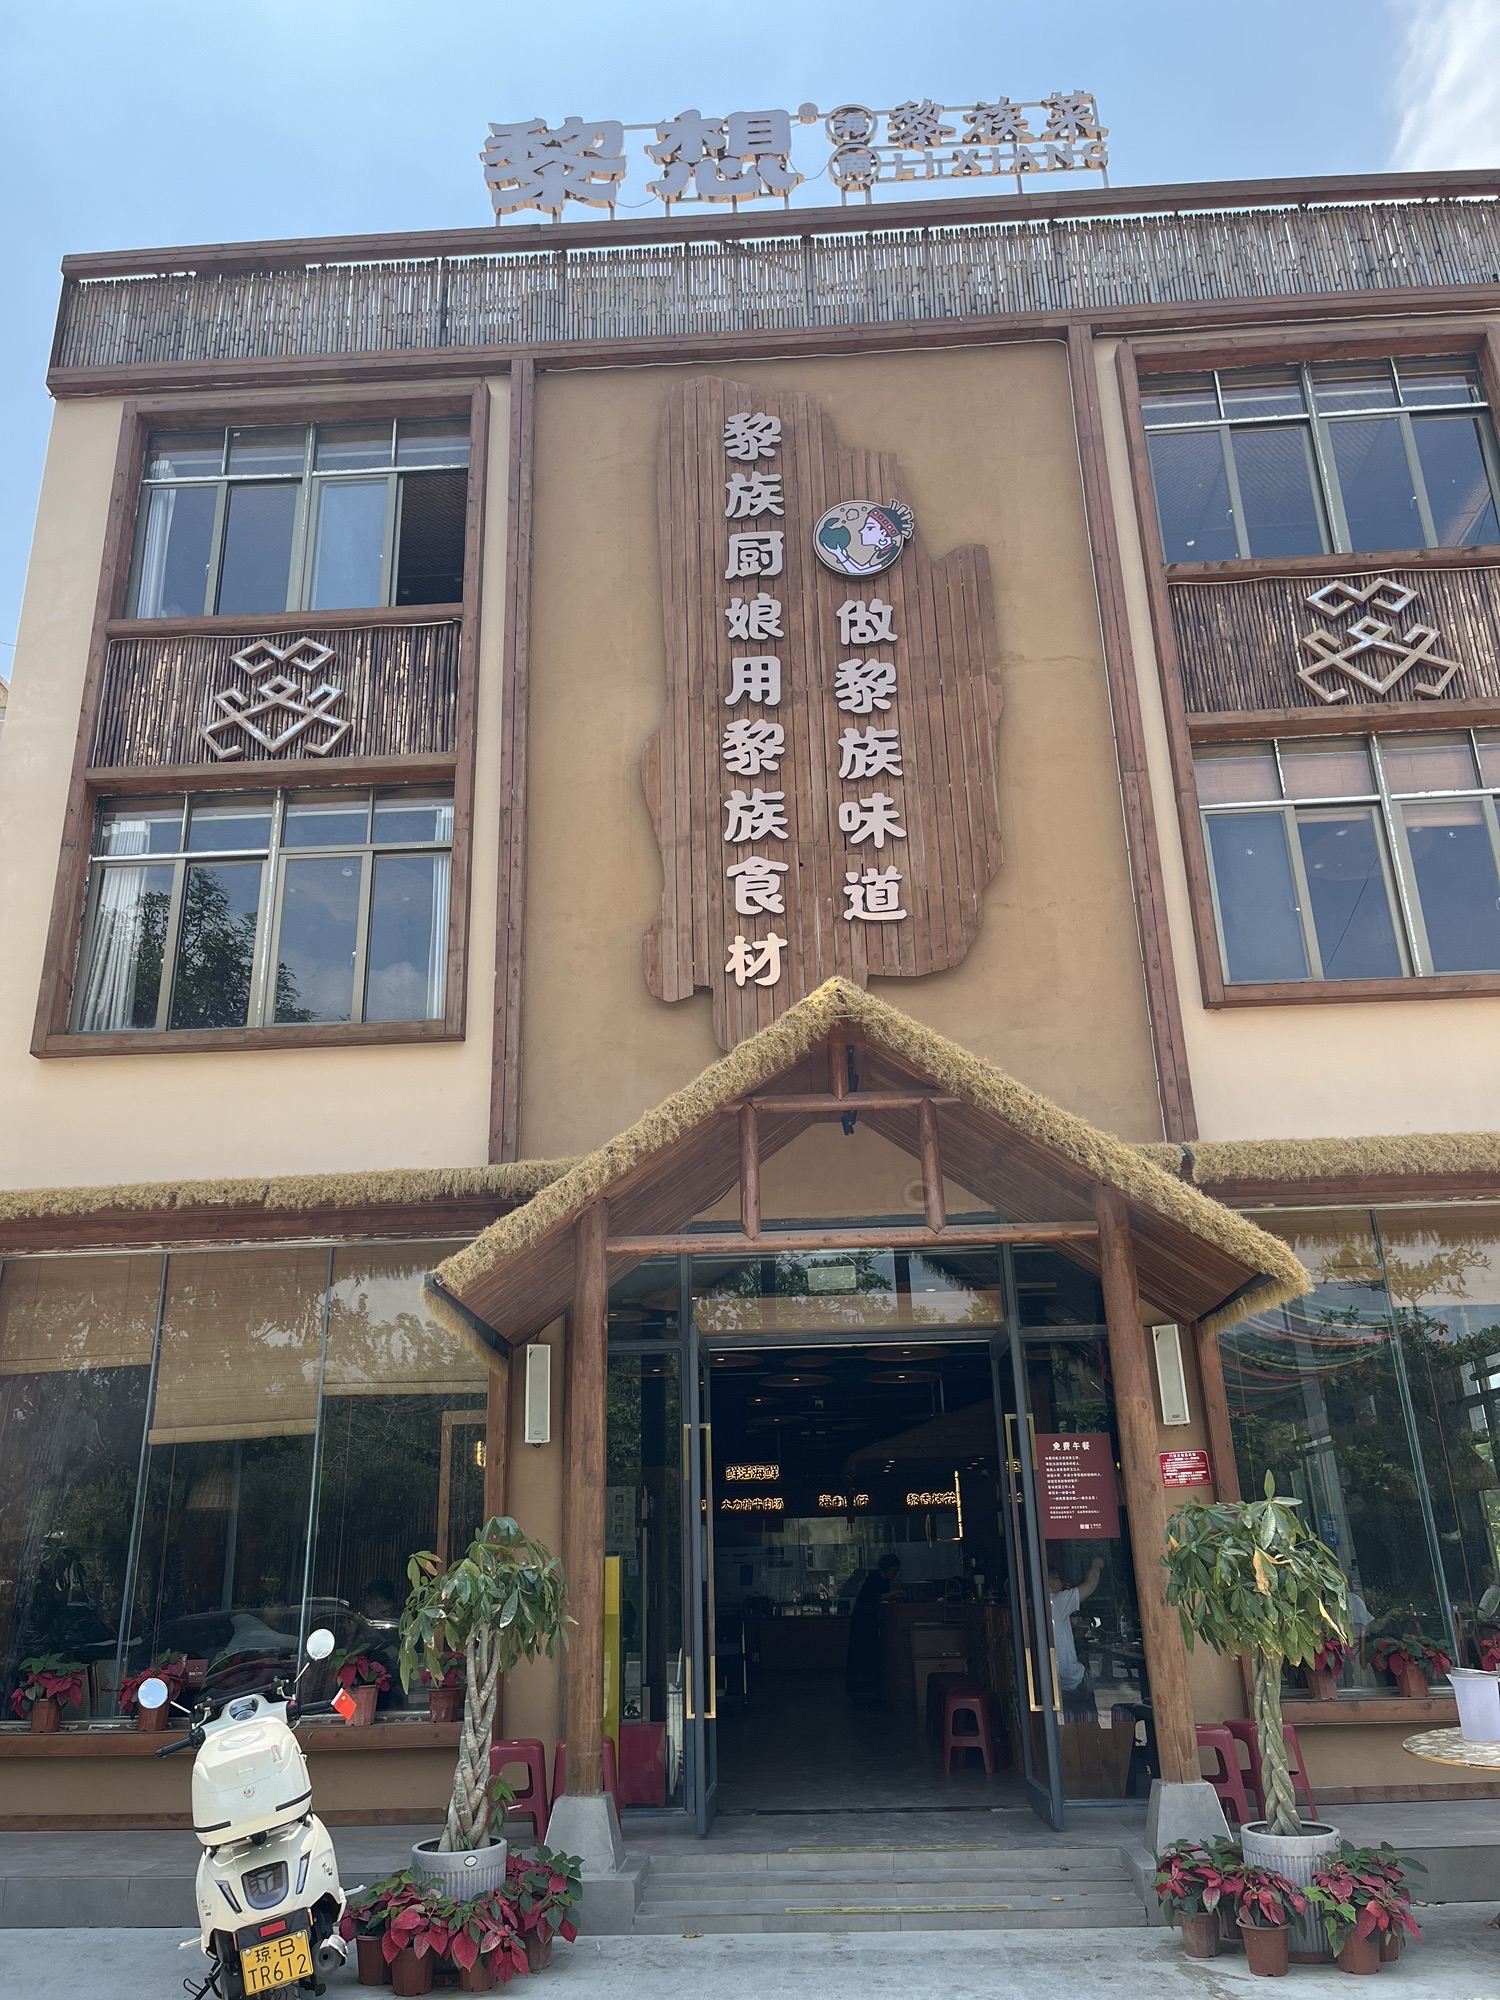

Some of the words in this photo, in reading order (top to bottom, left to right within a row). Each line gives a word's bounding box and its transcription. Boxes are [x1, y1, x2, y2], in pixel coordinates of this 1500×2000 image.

[829, 106, 880, 191] 海南
[888, 90, 1110, 151] 黎族菜
[480, 108, 803, 216] 黎想
[893, 141, 1109, 181] LIXIANG
[723, 411, 790, 988] 黎族厨娘用黎族食材
[835, 598, 908, 922] 做黎族味道
[725, 1464, 780, 1482] 鲜活海鲜
[248, 1953, 308, 1990] TR612
